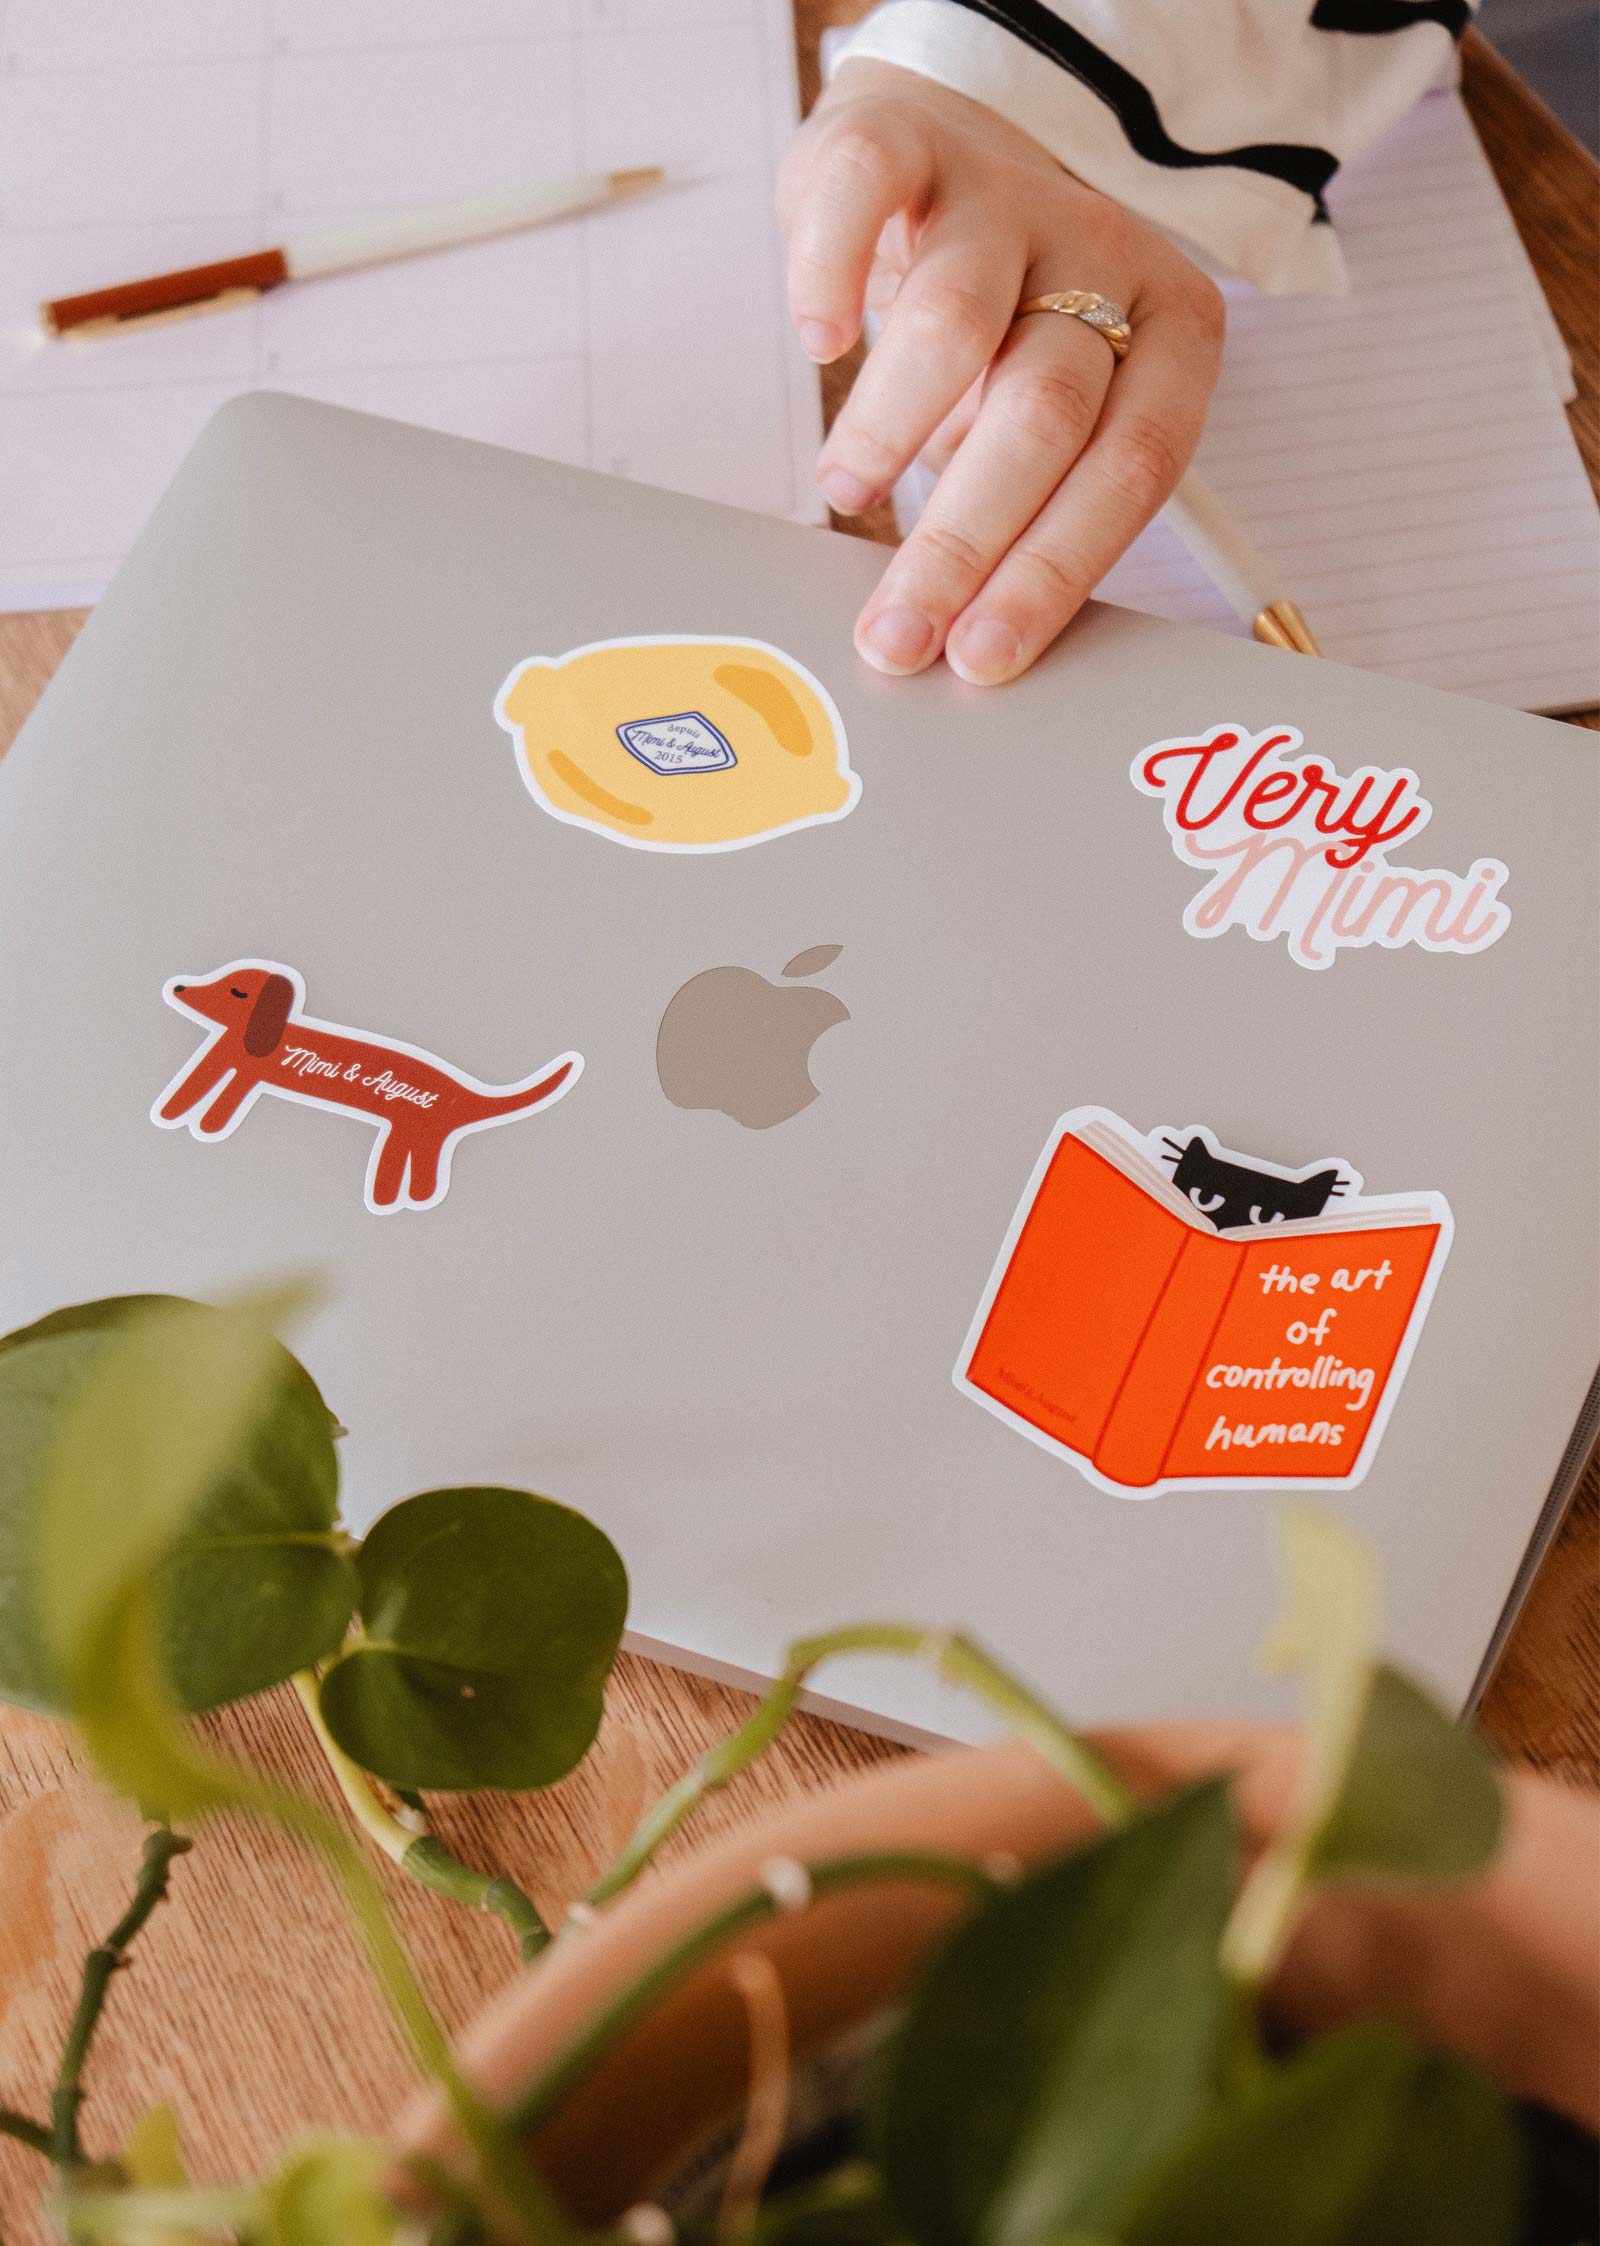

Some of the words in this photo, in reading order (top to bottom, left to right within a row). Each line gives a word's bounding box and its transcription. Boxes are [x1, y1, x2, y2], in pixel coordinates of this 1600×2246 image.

[632, 728, 665, 746] Mimi
[666, 738, 676, 748] &
[677, 741, 721, 757] August
[667, 724, 701, 738] depuis
[654, 750, 683, 764] 2015
[1143, 732, 1421, 869] Very
[1185, 833, 1499, 960] Mimi
[281, 1045, 342, 1078] Mimi
[343, 1063, 362, 1083] &
[363, 1070, 438, 1108] August
[1258, 1264, 1321, 1295] the
[1330, 1259, 1393, 1292] art
[1286, 1308, 1338, 1347] of
[1206, 1355, 1375, 1411] controlling
[1204, 1415, 1346, 1451] humans
